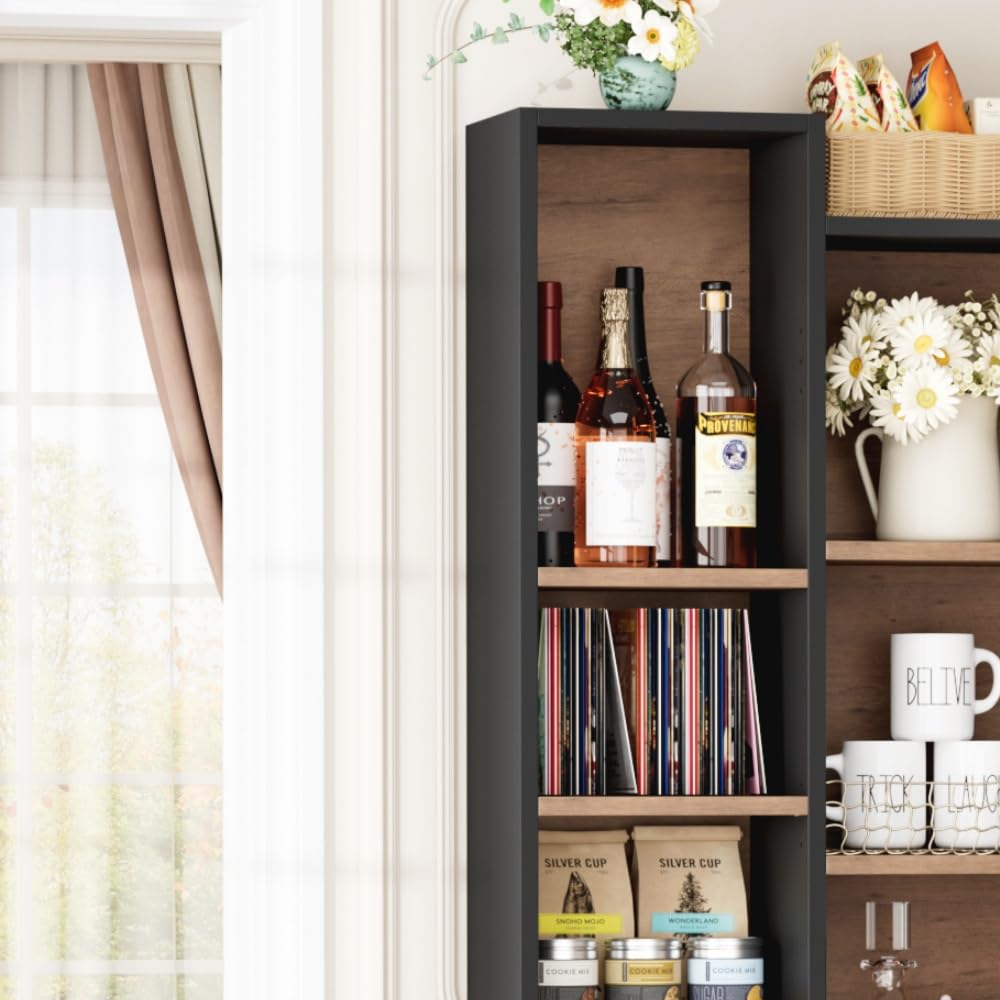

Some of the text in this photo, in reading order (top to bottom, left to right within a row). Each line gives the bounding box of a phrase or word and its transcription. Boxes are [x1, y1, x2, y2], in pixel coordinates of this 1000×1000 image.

[857, 774, 914, 813] TRICK
[544, 858, 607, 868] SILVER CUP
[659, 858, 721, 868] SILVER CUP
[629, 968, 660, 976] COOKIE
